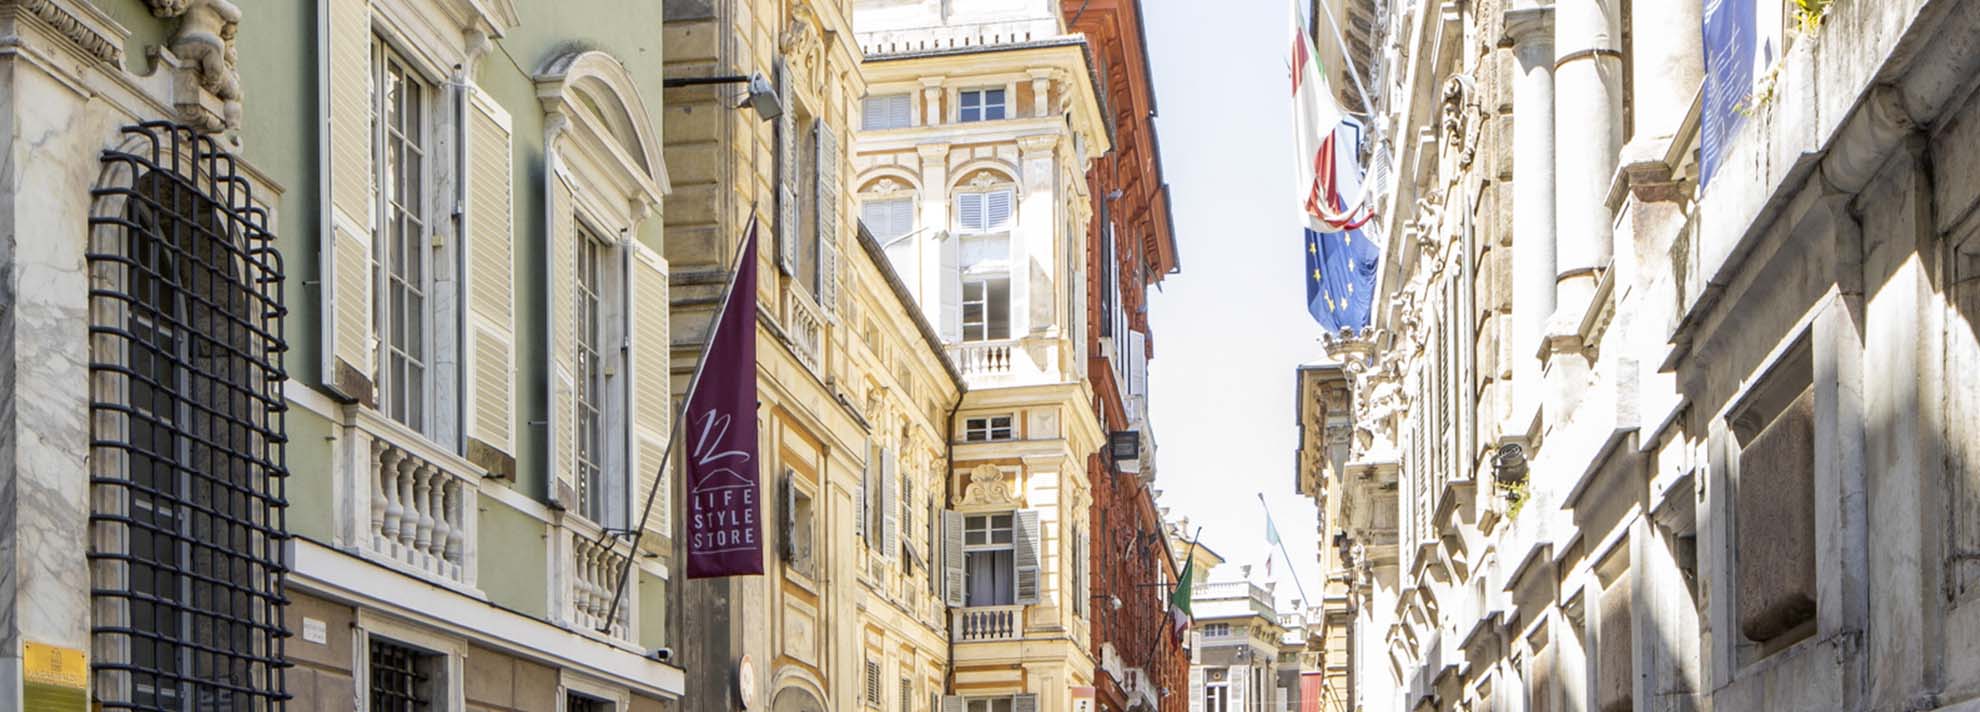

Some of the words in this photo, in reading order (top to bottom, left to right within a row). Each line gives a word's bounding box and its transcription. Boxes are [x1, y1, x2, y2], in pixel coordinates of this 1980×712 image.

[693, 408, 751, 465] 12
[694, 489, 753, 510] LIFE
[694, 508, 753, 529] STYLE
[694, 528, 754, 548] STORE
